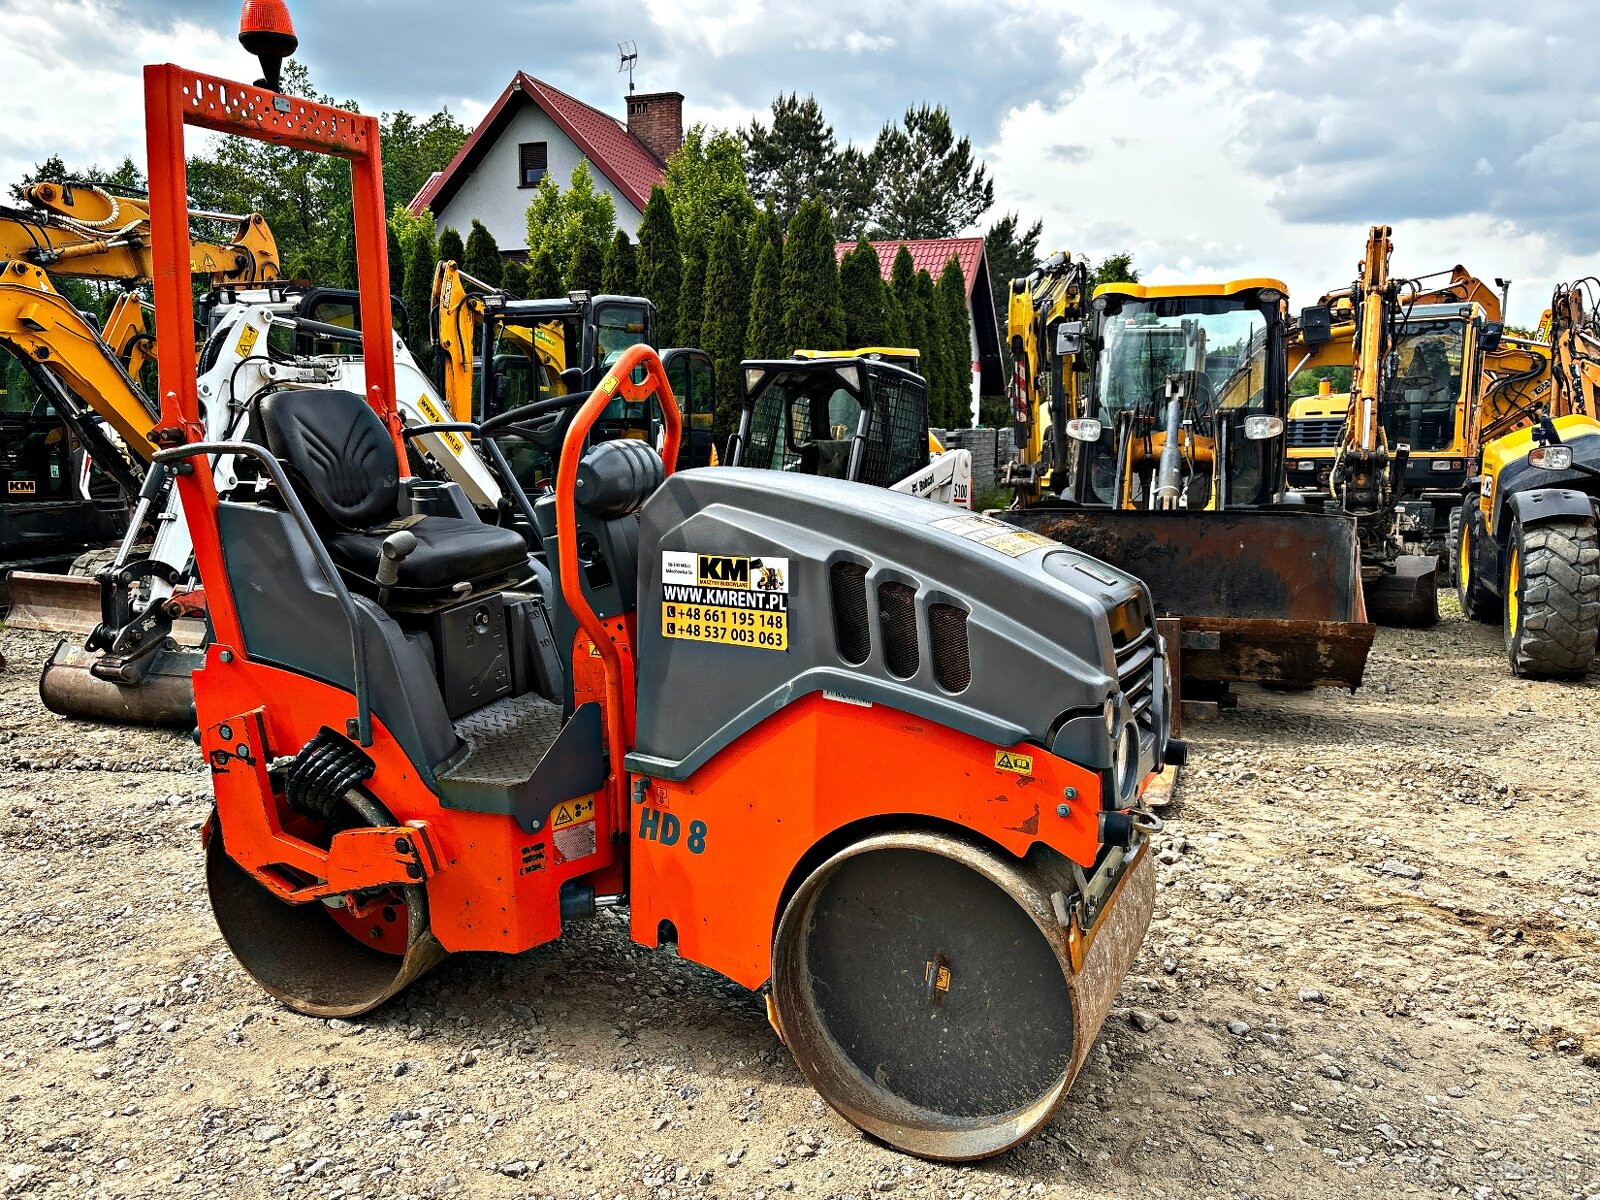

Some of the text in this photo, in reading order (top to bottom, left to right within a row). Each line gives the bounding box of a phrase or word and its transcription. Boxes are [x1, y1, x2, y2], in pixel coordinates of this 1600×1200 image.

[10, 481, 34, 490] KM
[919, 473, 935, 492] Bobcat
[954, 483, 967, 498] S100
[700, 556, 748, 581] KM
[720, 580, 748, 588] BUDOWLANE
[664, 585, 787, 610] WWW.KMRENT.PL
[677, 607, 783, 629] +48 661 195 148
[677, 624, 783, 646] +48 537 003 063
[639, 806, 708, 854] HD 8
